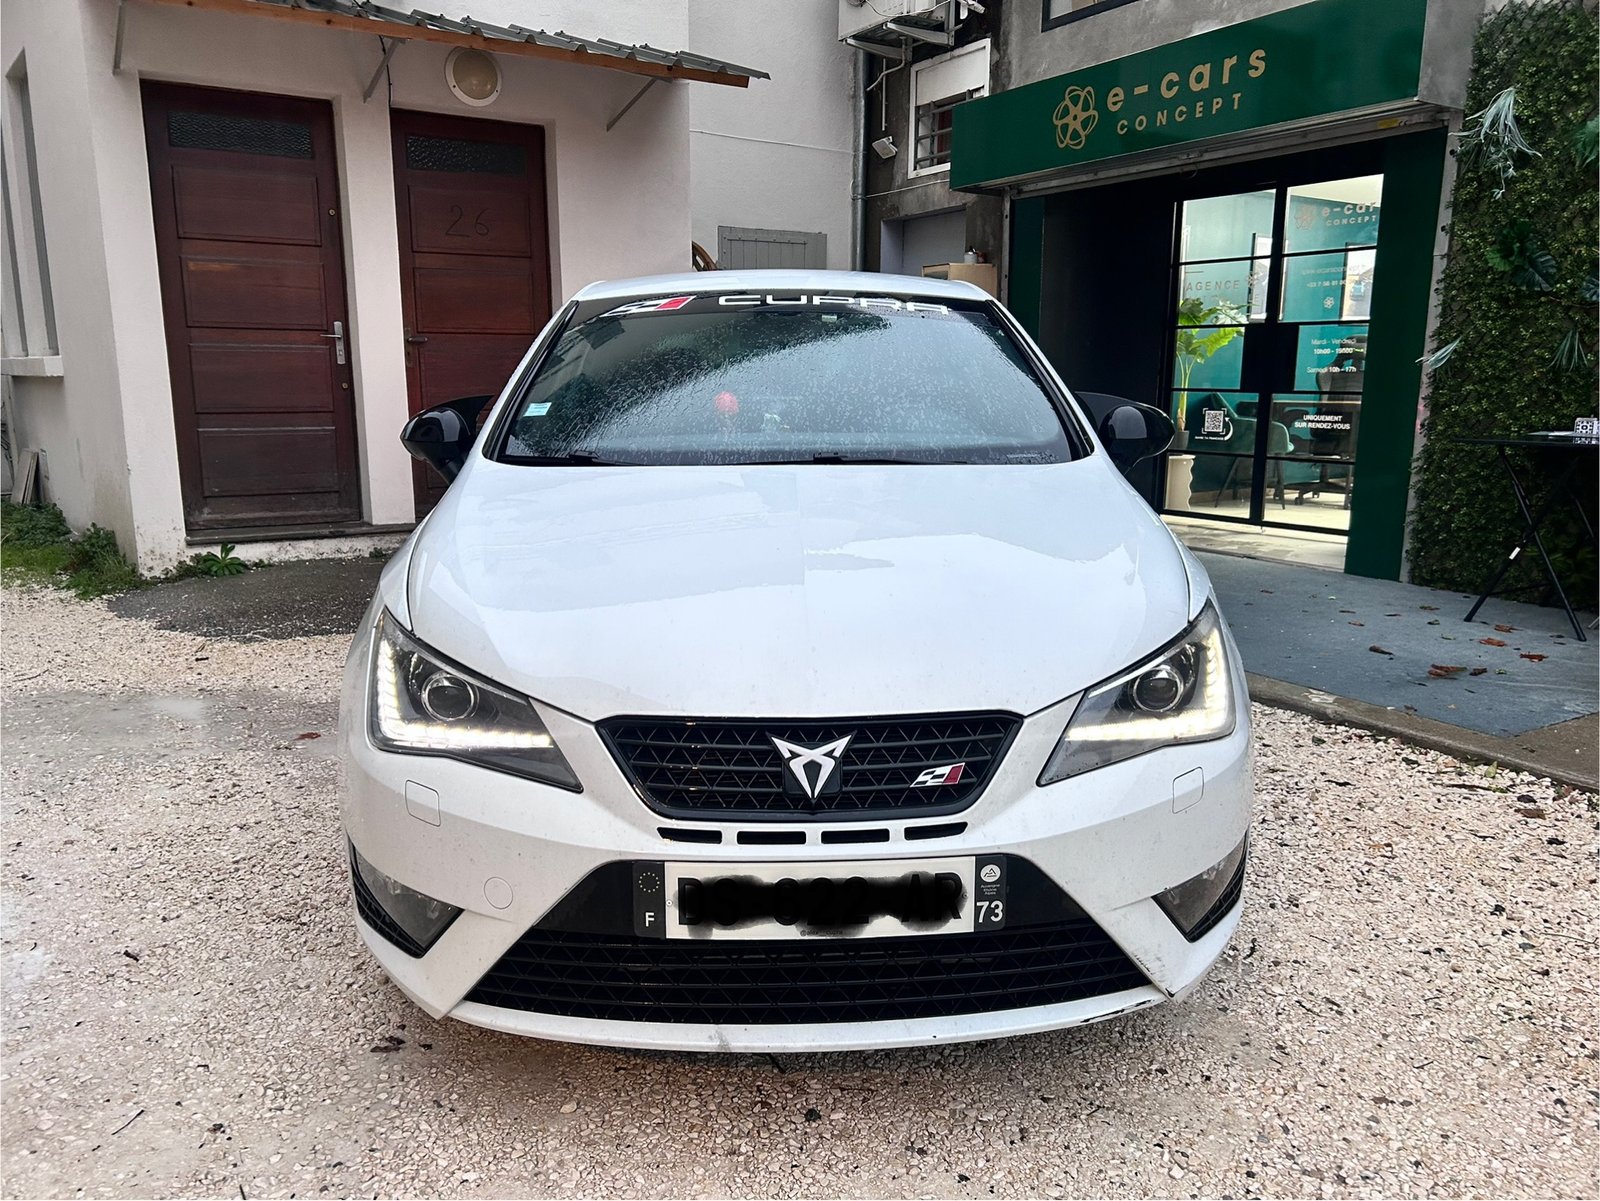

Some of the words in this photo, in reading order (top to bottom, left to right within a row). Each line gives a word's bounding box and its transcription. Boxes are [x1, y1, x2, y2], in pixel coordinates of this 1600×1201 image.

[1106, 49, 1266, 112] e-cars
[1117, 93, 1242, 135] CONCEPT
[1321, 202, 1377, 217] e-car
[445, 204, 490, 238] 26
[1326, 215, 1377, 226] CONCEPT
[1186, 280, 1240, 292] AGENCE
[718, 294, 953, 316] CUPRA
[1303, 414, 1343, 422] UNIQUEMENT
[1307, 422, 1351, 430] RENDEZ-VOUS
[645, 911, 655, 927] F
[976, 900, 1004, 923] 73
